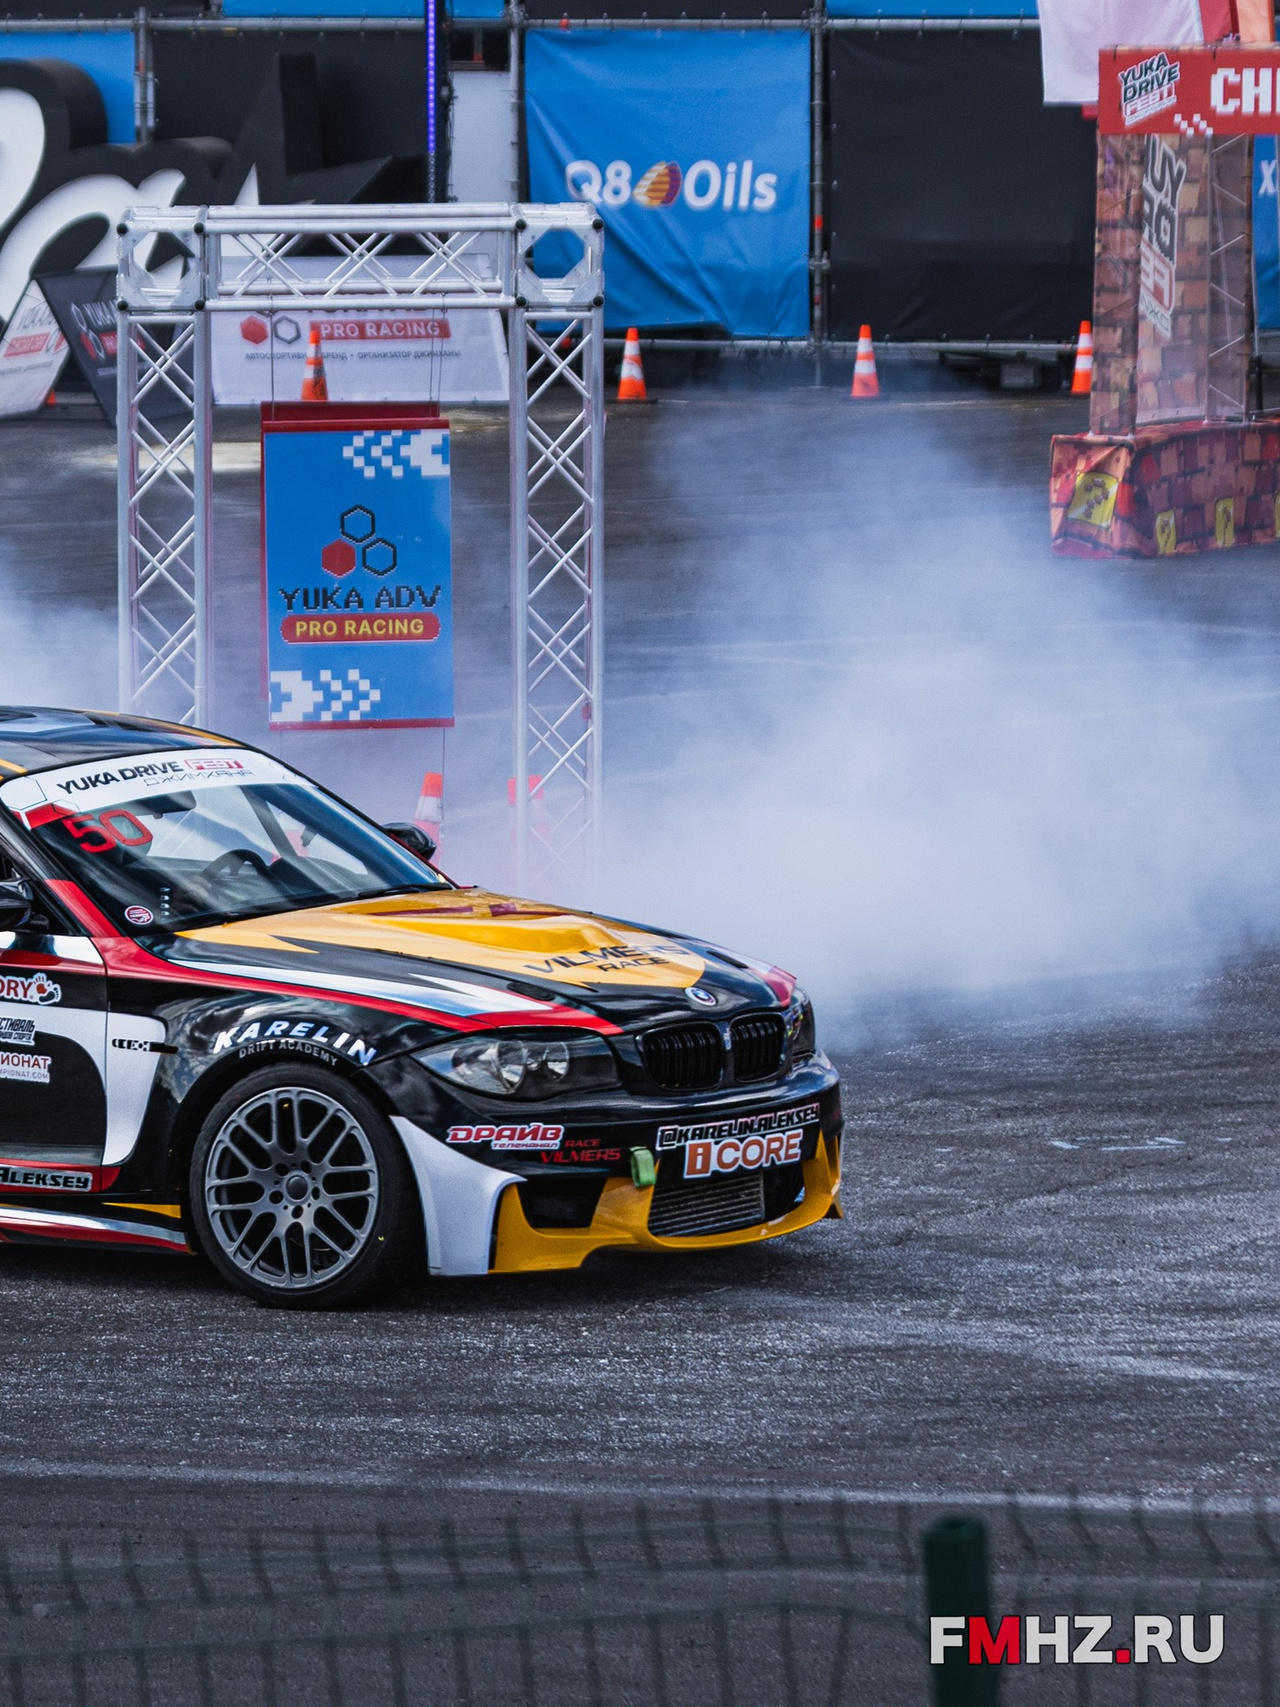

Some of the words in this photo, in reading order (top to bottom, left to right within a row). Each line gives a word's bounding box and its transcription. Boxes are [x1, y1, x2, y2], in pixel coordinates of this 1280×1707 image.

[1120, 53, 1168, 86] YUKA
[1123, 64, 1179, 102] DRIVE
[1210, 67, 1280, 115] CH
[566, 160, 631, 205] Q8
[684, 160, 778, 208] Oils
[320, 322, 359, 338] PRO
[365, 321, 440, 338] RACING
[279, 586, 365, 612] YUKA
[374, 584, 442, 610] ADV
[295, 619, 337, 637] PRO
[344, 618, 425, 636] RACING
[56, 772, 120, 795] YUKA
[119, 761, 184, 781] DRIVE
[186, 758, 243, 771] FEST
[61, 808, 154, 854] 50
[596, 956, 671, 973] RACE
[213, 1020, 378, 1067] KARELIN
[239, 1039, 276, 1059] DRIFT
[278, 1039, 338, 1067] ACADEMY
[449, 1124, 563, 1142] ДРАЙВ
[564, 1138, 601, 1149] RACE
[541, 1147, 621, 1164] VILMERS
